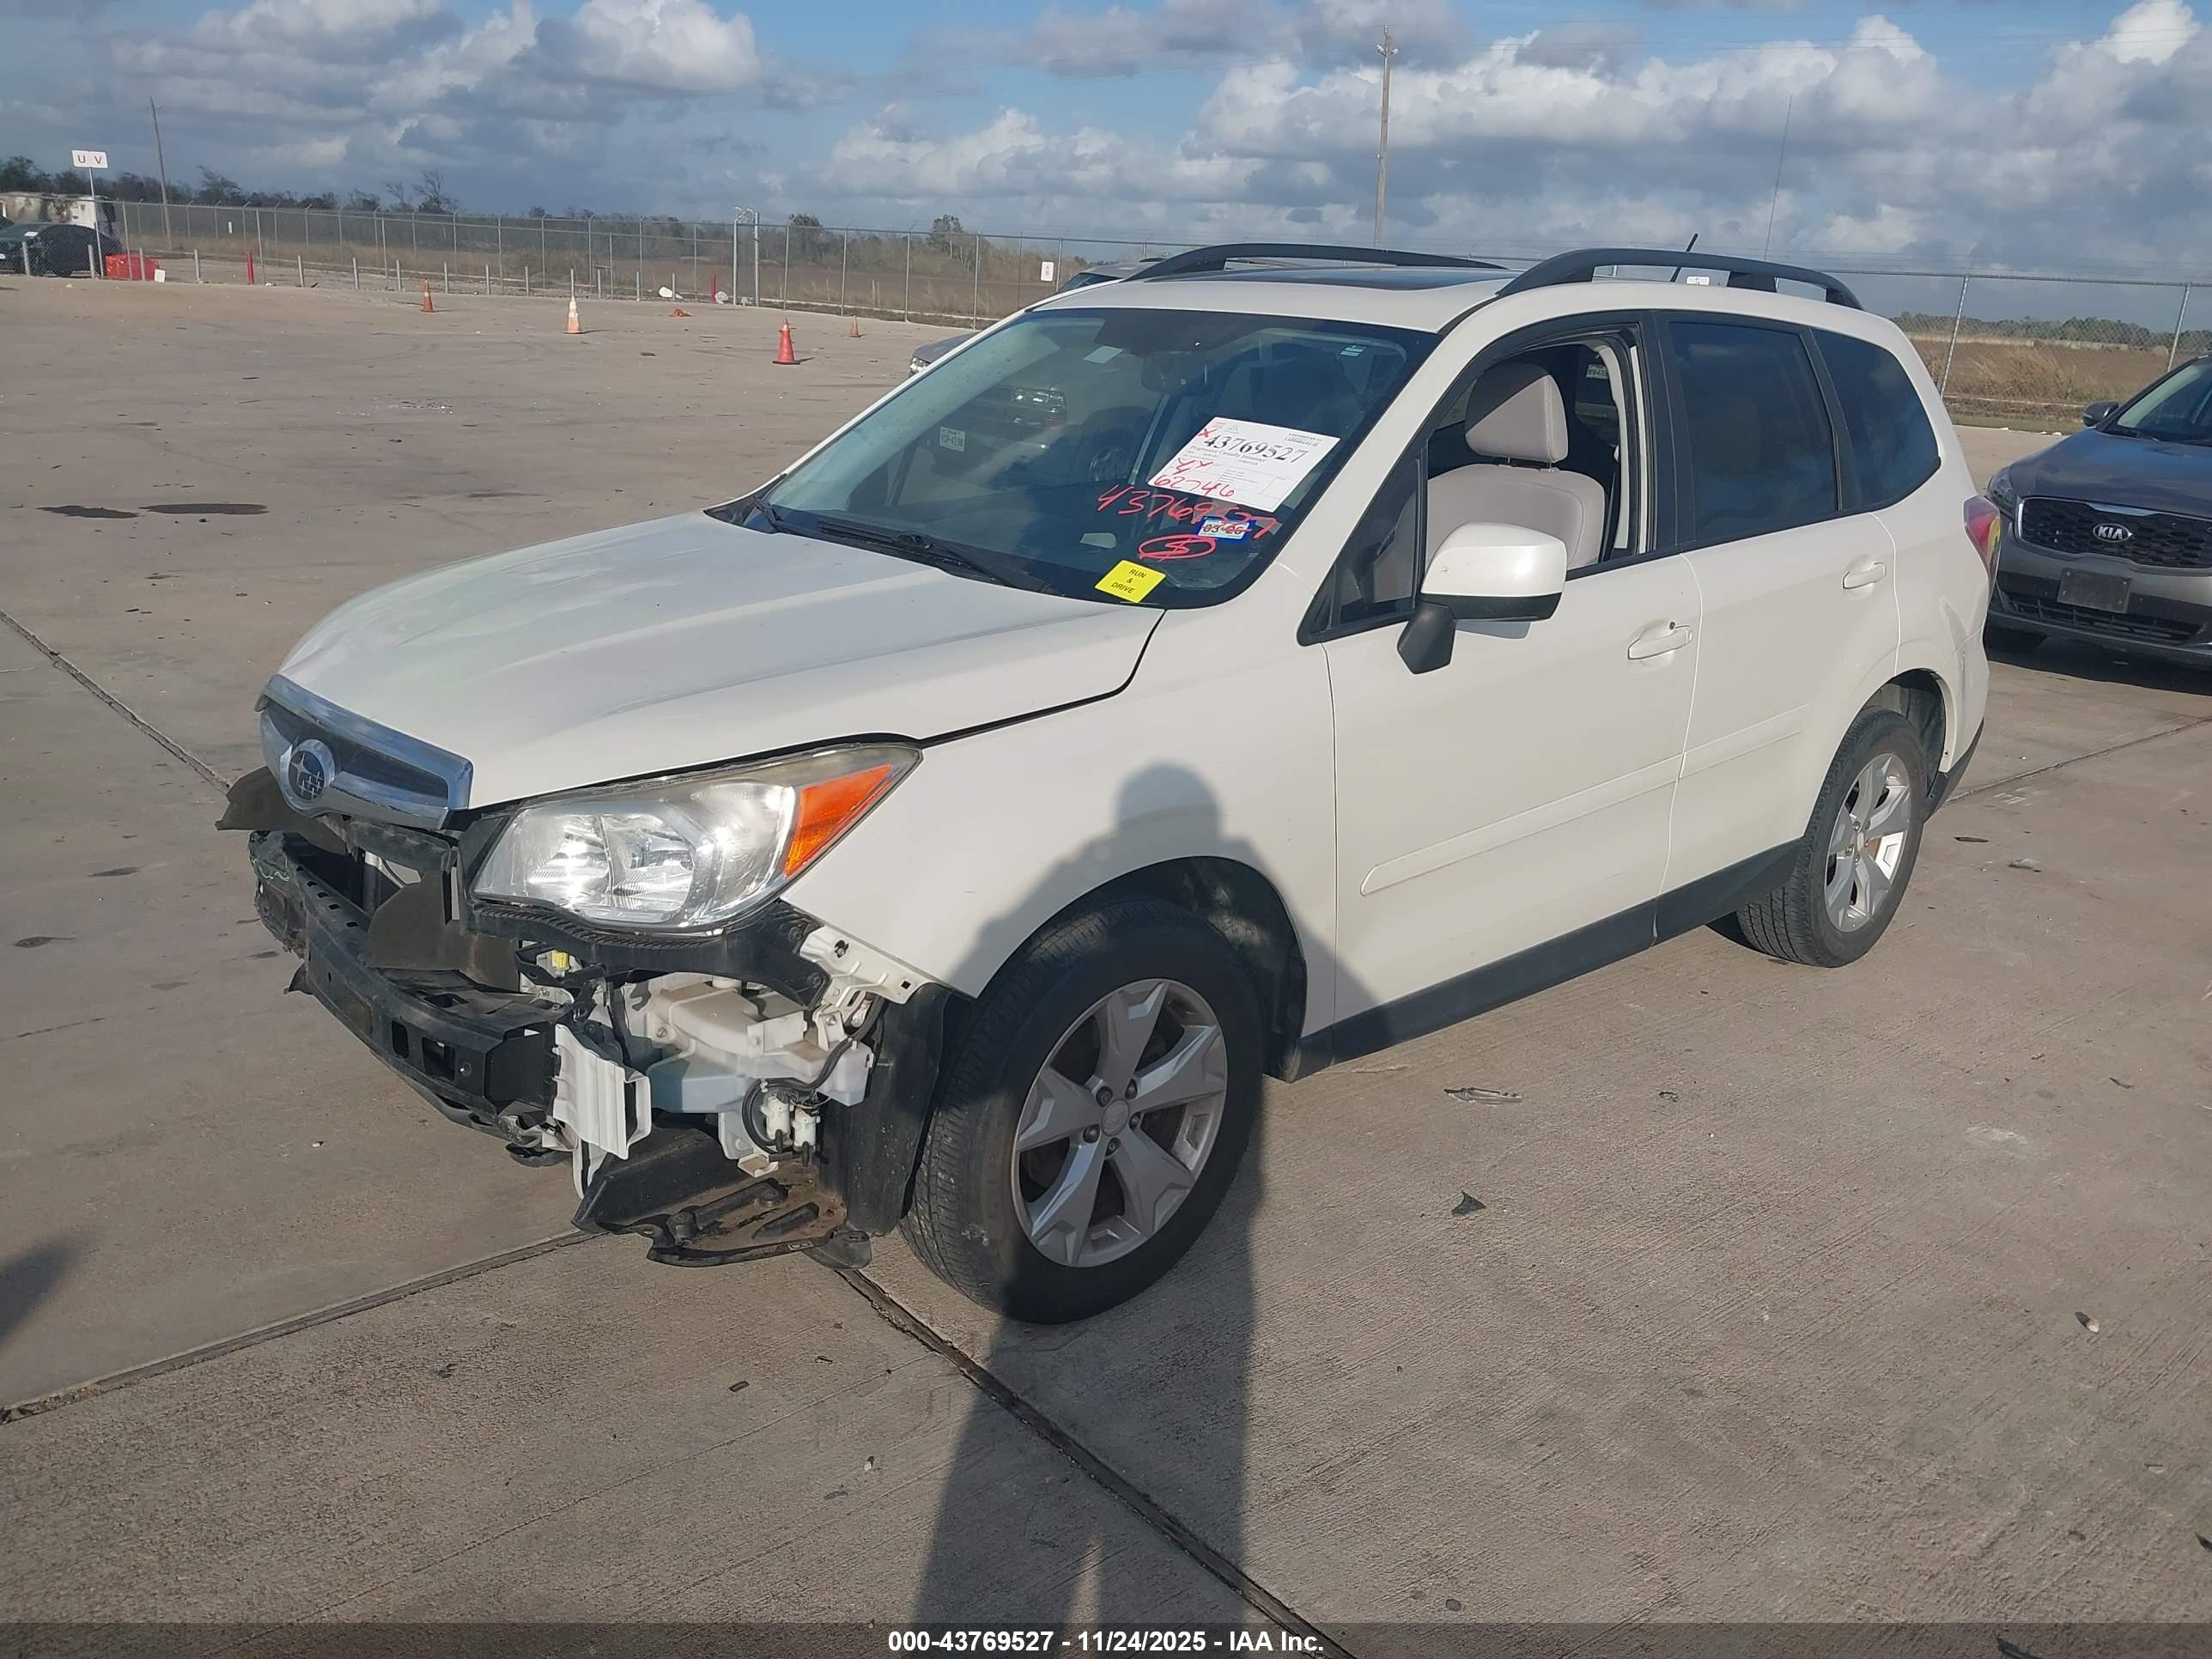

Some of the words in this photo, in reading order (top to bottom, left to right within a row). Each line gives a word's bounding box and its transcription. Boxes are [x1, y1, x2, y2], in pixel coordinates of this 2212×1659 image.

[78, 155, 86, 163] U
[94, 155, 102, 164] V
[1204, 434, 1310, 463] 43769527
[2098, 526, 2123, 540] KIA
[1128, 568, 1147, 578] RUN
[1111, 582, 1136, 593] DRIVE
